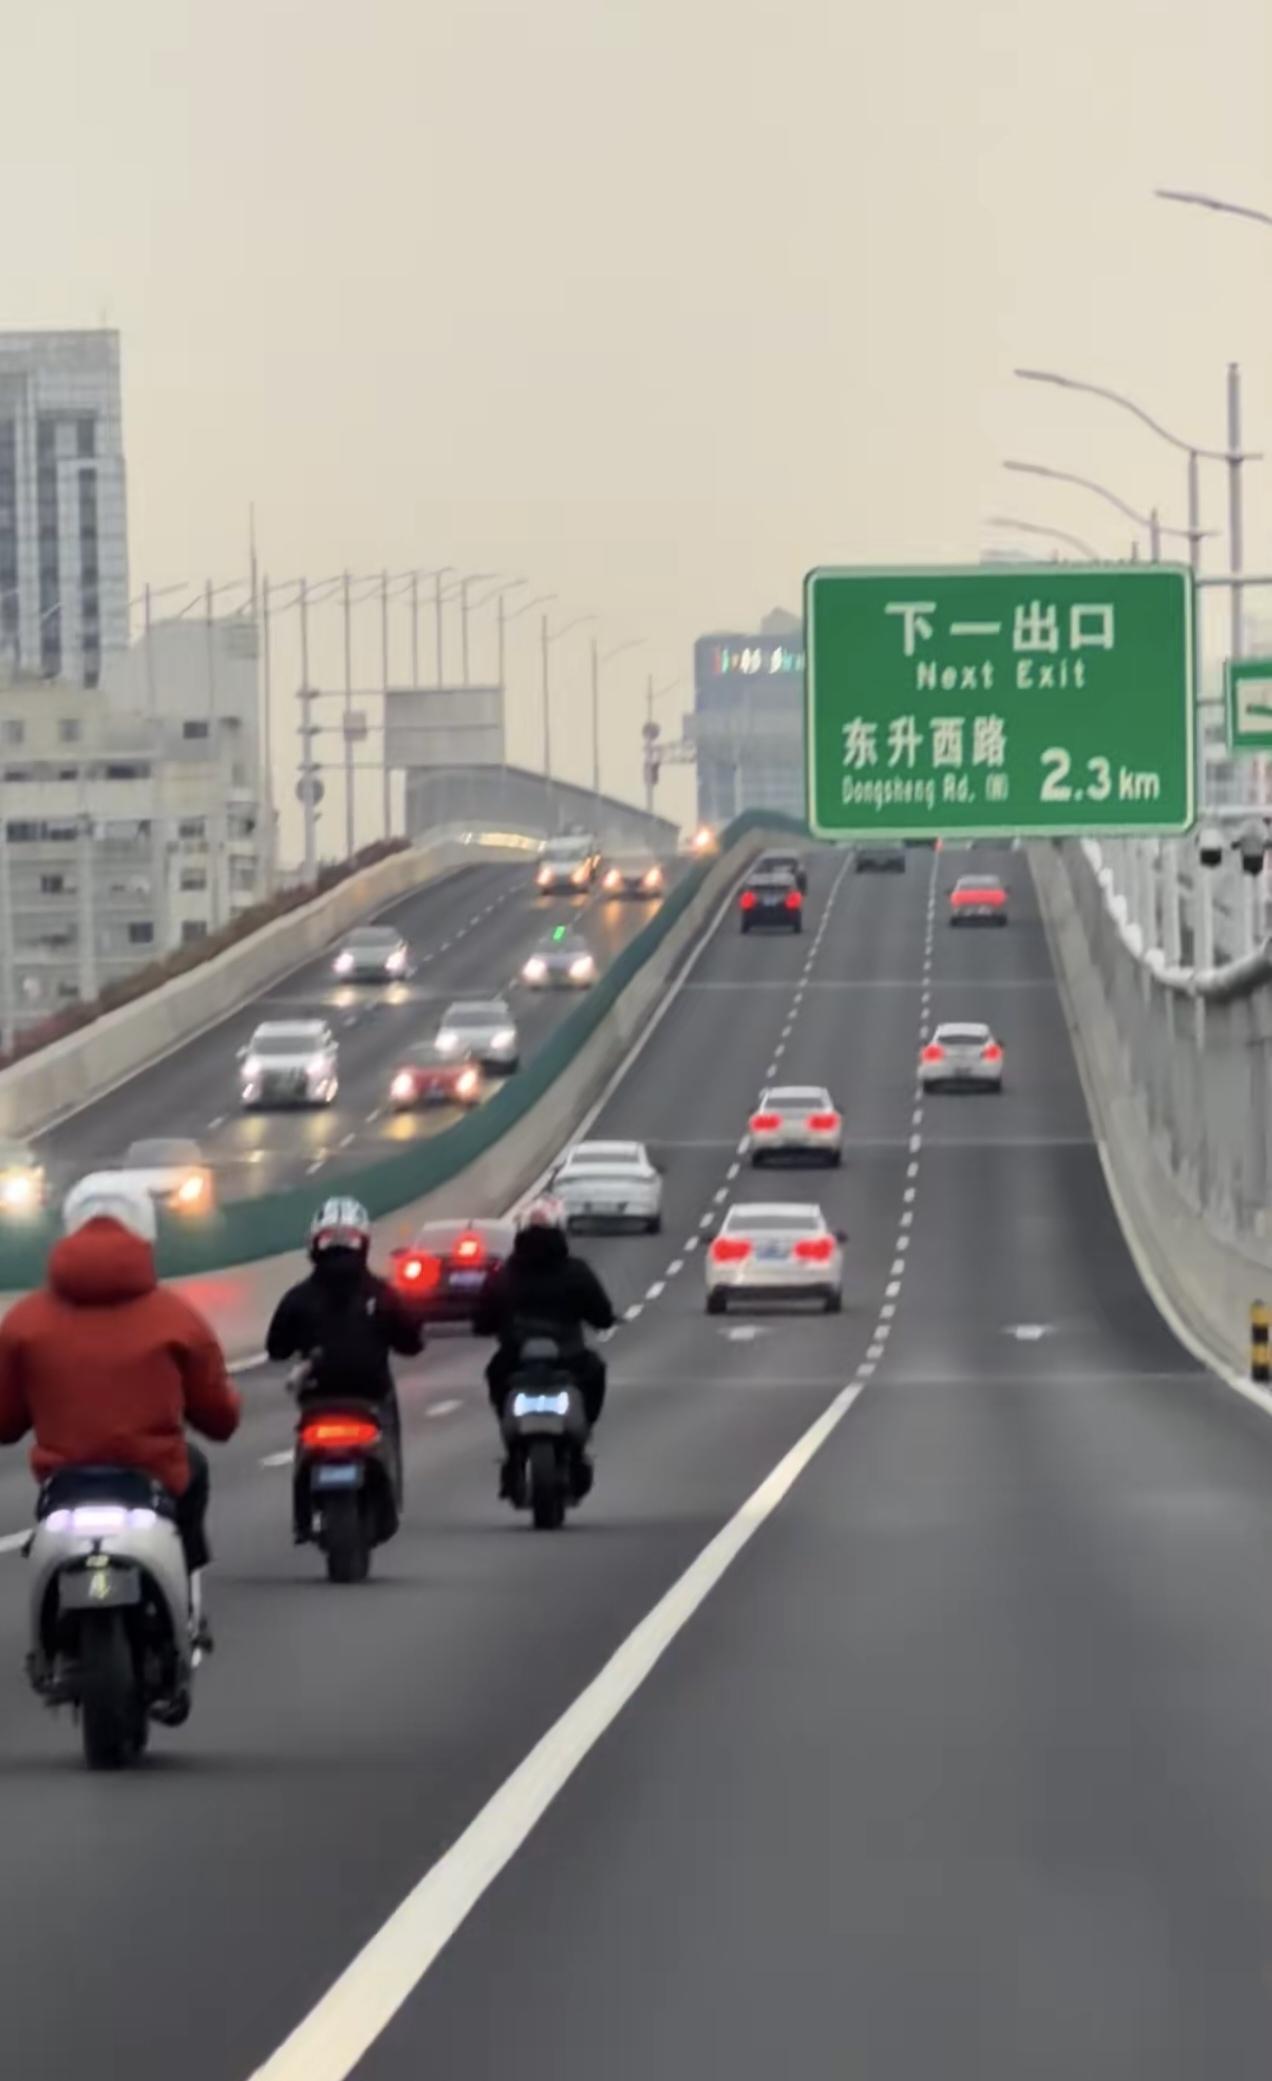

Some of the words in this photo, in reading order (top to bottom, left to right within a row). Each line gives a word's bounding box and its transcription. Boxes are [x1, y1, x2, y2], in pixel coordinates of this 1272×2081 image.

[884, 600, 1115, 657] 下一出口
[916, 660, 993, 691] Next
[1016, 658, 1085, 690] Exit
[842, 714, 1007, 770] 东升西路
